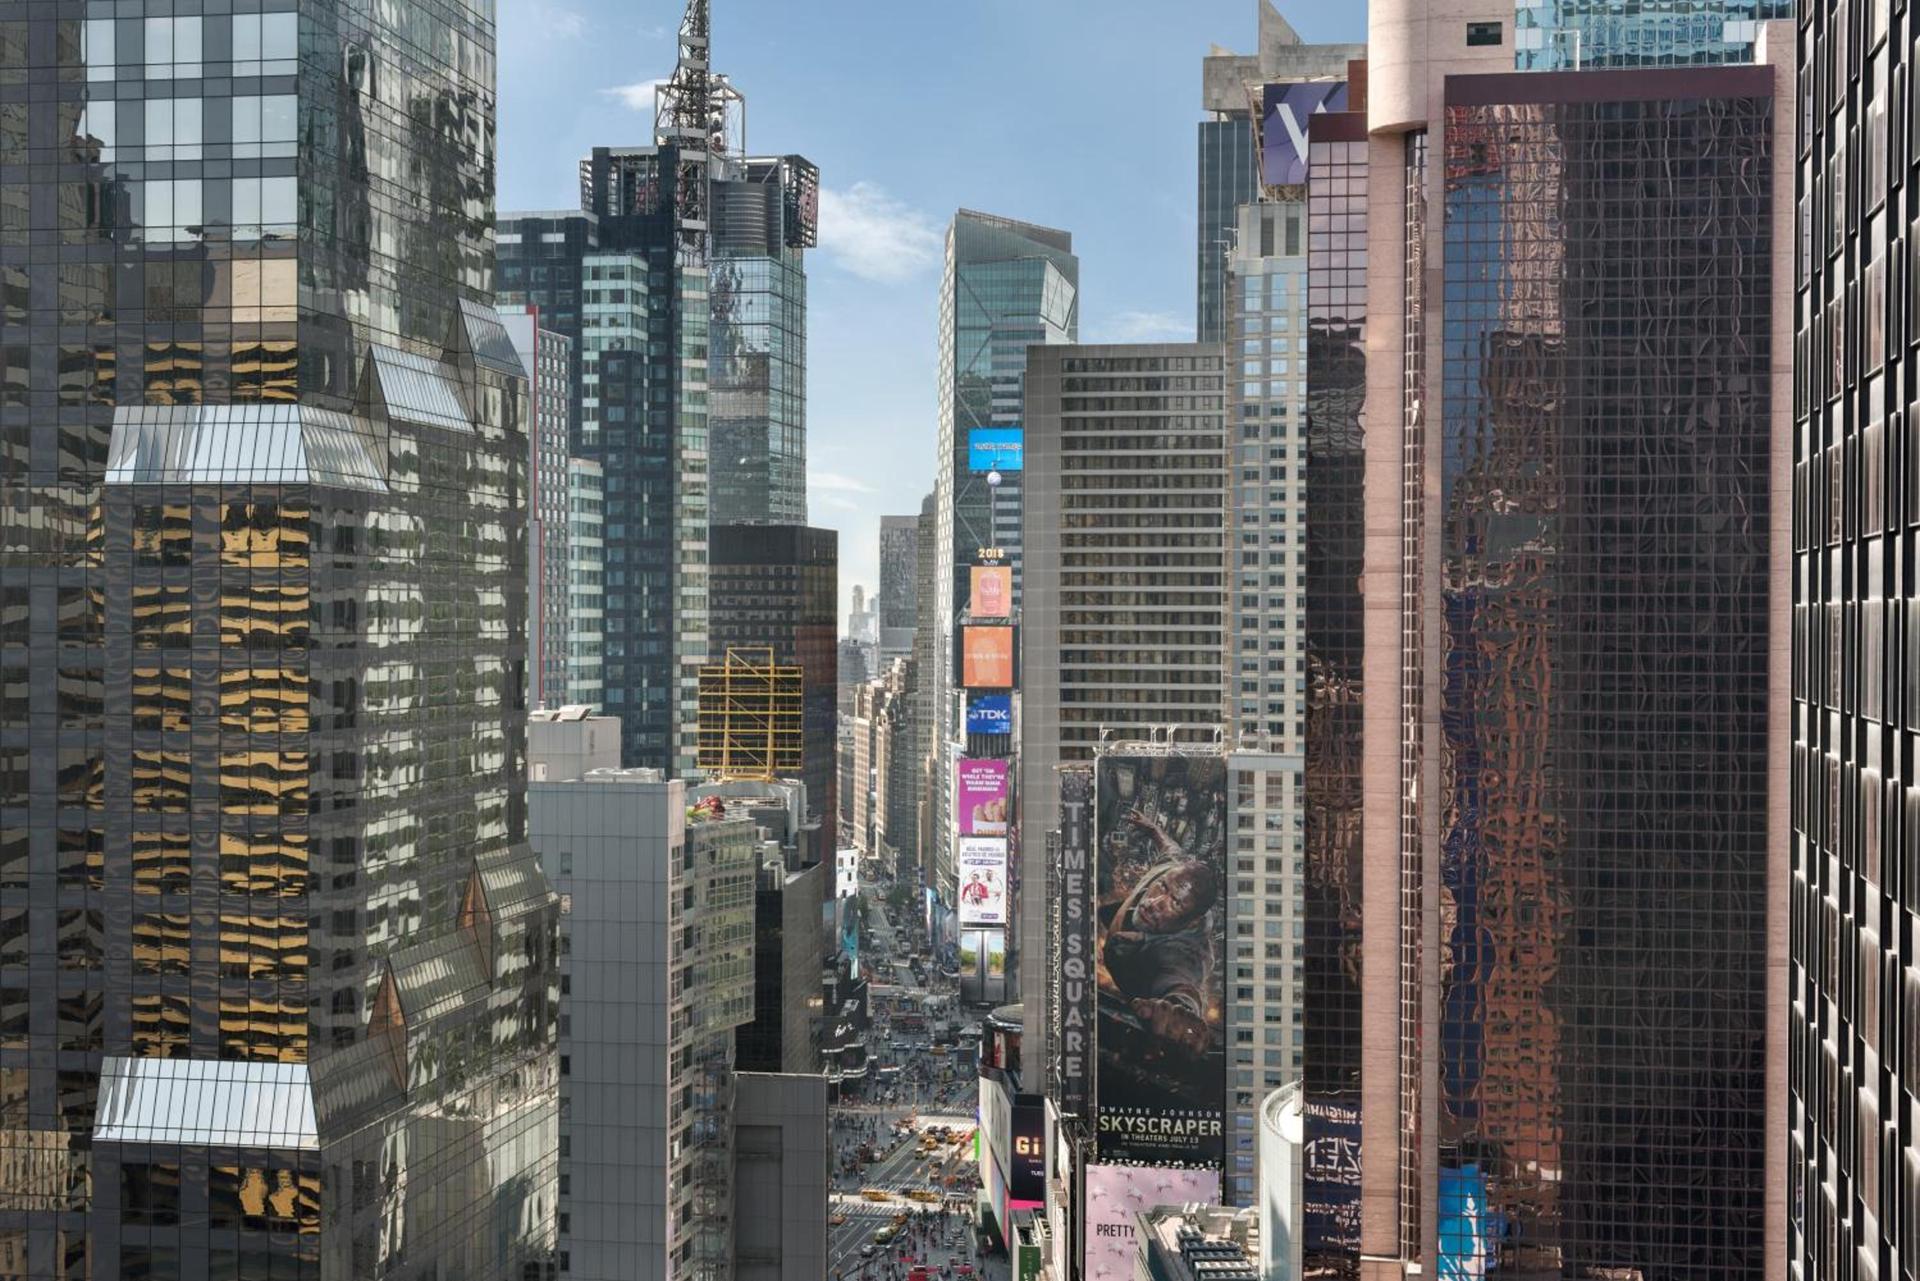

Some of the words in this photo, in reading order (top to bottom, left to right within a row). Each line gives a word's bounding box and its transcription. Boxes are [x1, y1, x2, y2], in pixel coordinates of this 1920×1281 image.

[978, 548, 1004, 558] 2018
[983, 709, 1007, 720] TDK
[1064, 802, 1085, 918] TIMES
[1064, 933, 1086, 1077] SQUARE
[1100, 1106, 1150, 1116] DWAYNE
[1161, 1109, 1221, 1118] JOHNSON
[1099, 1115, 1222, 1136] SKYSCRAPER
[1131, 1134, 1168, 1142] THEATERS
[1096, 1223, 1135, 1238] PRETTY
